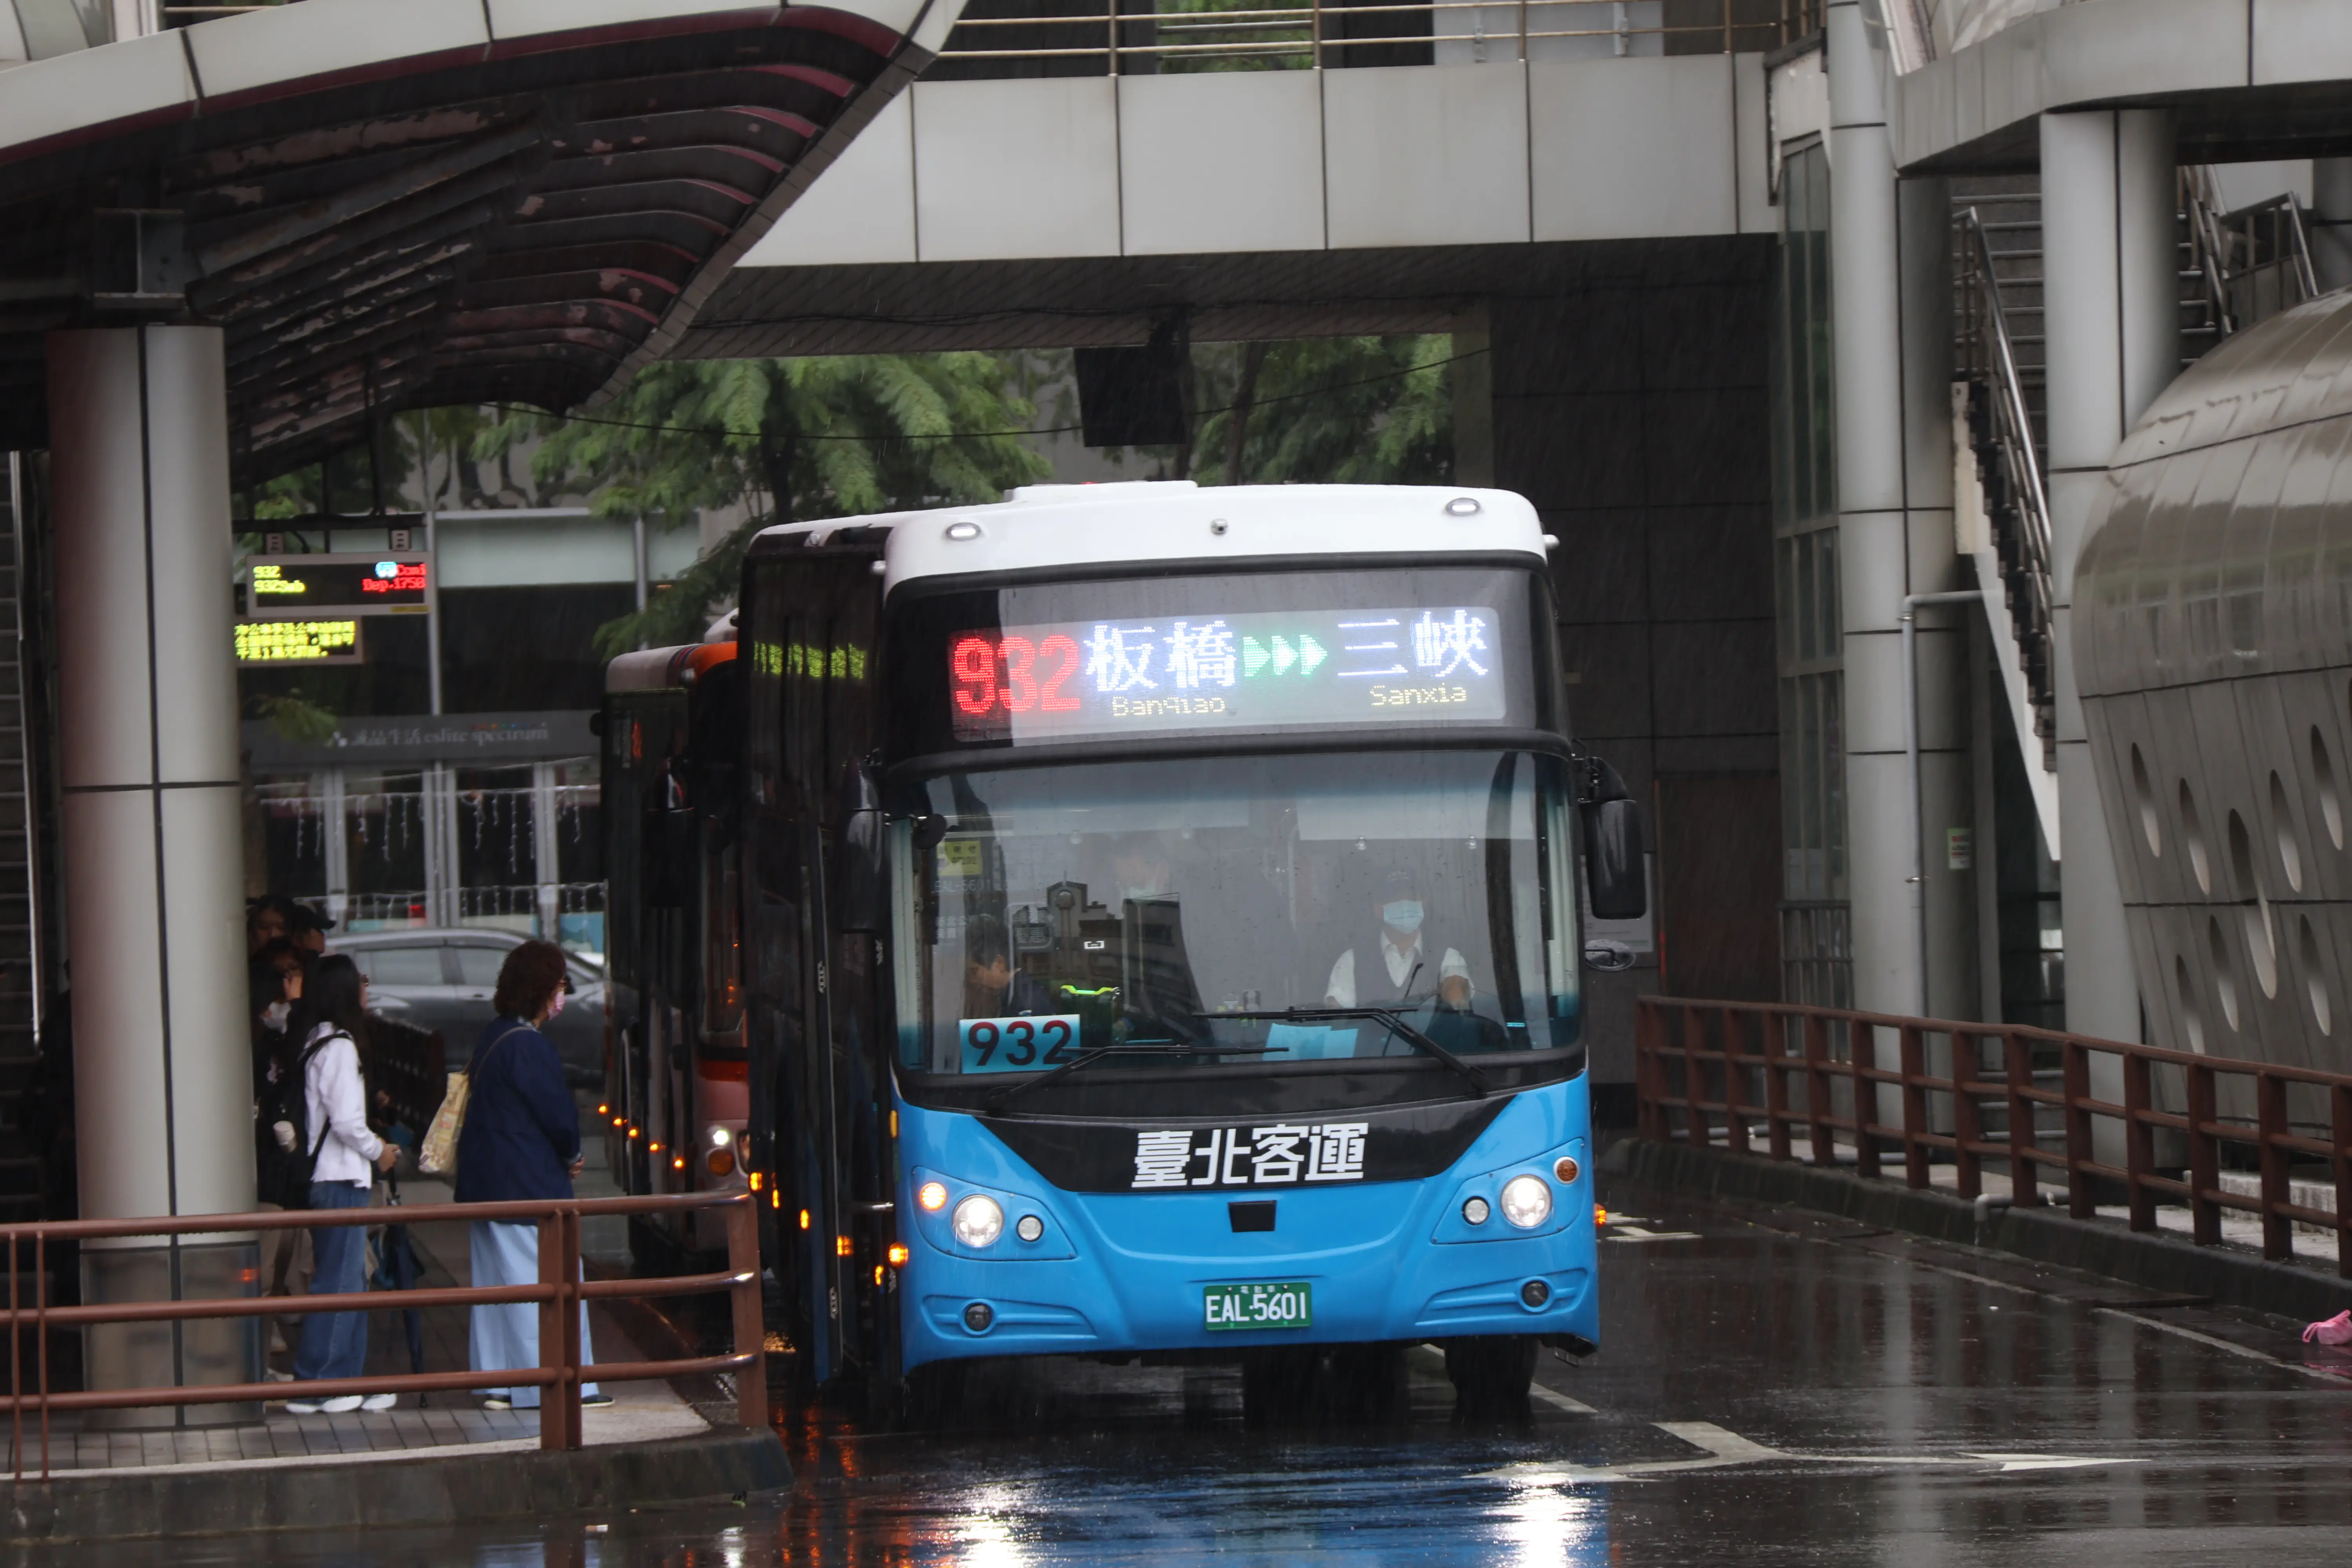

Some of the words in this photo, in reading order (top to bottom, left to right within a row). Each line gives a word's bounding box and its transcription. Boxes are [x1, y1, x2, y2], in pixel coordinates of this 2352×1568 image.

[253, 565, 281, 579] 932
[954, 634, 1080, 713] 932
[1083, 621, 1237, 691] 板橋
[1338, 610, 1488, 677] 三峽
[1112, 696, 1225, 716] Banqiao
[1370, 682, 1467, 706] Sanxia
[969, 1020, 1072, 1066] 932
[1131, 1123, 1368, 1187] 臺北客運
